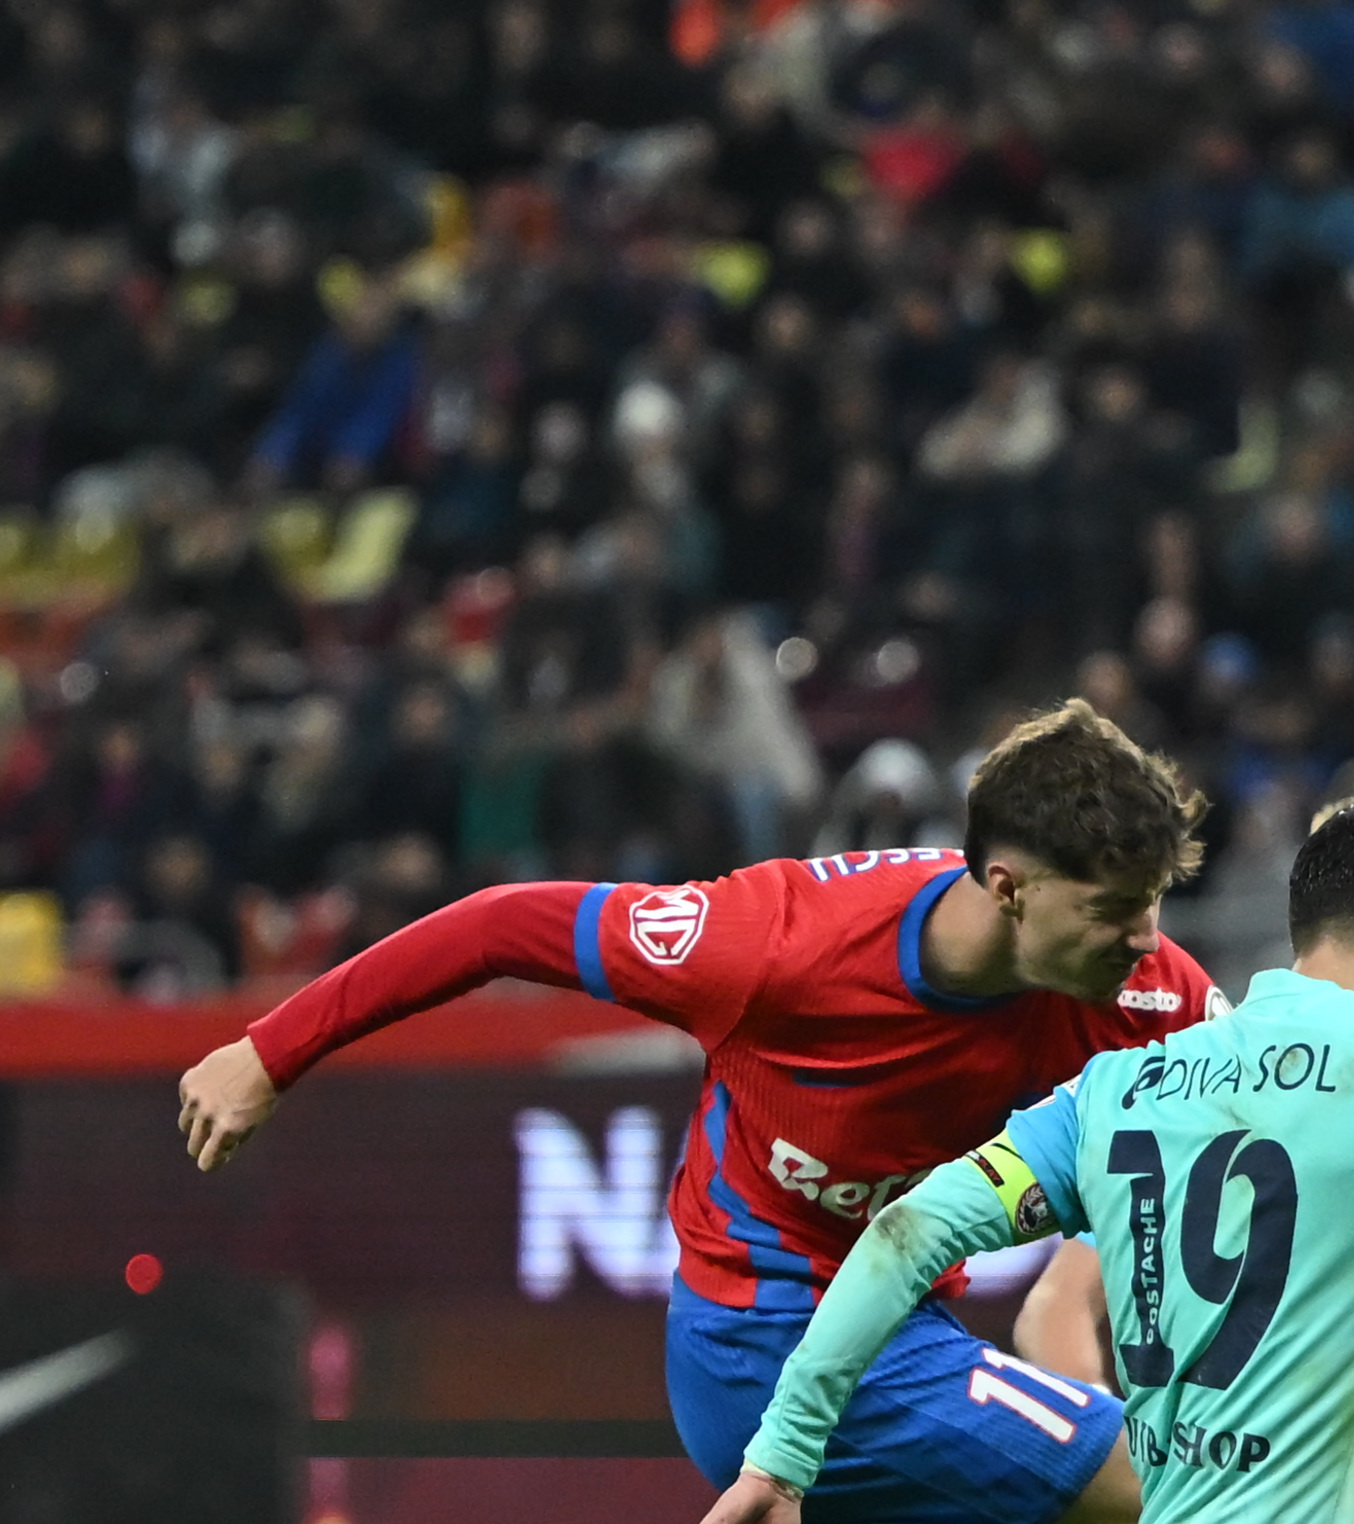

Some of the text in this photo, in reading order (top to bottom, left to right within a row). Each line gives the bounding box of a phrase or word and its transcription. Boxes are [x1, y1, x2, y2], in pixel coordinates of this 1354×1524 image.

[1252, 1042, 1337, 1093] SOL
[767, 1137, 933, 1222] Bet
[1106, 1129, 1299, 1391] 19
[967, 1347, 1092, 1445] 11
